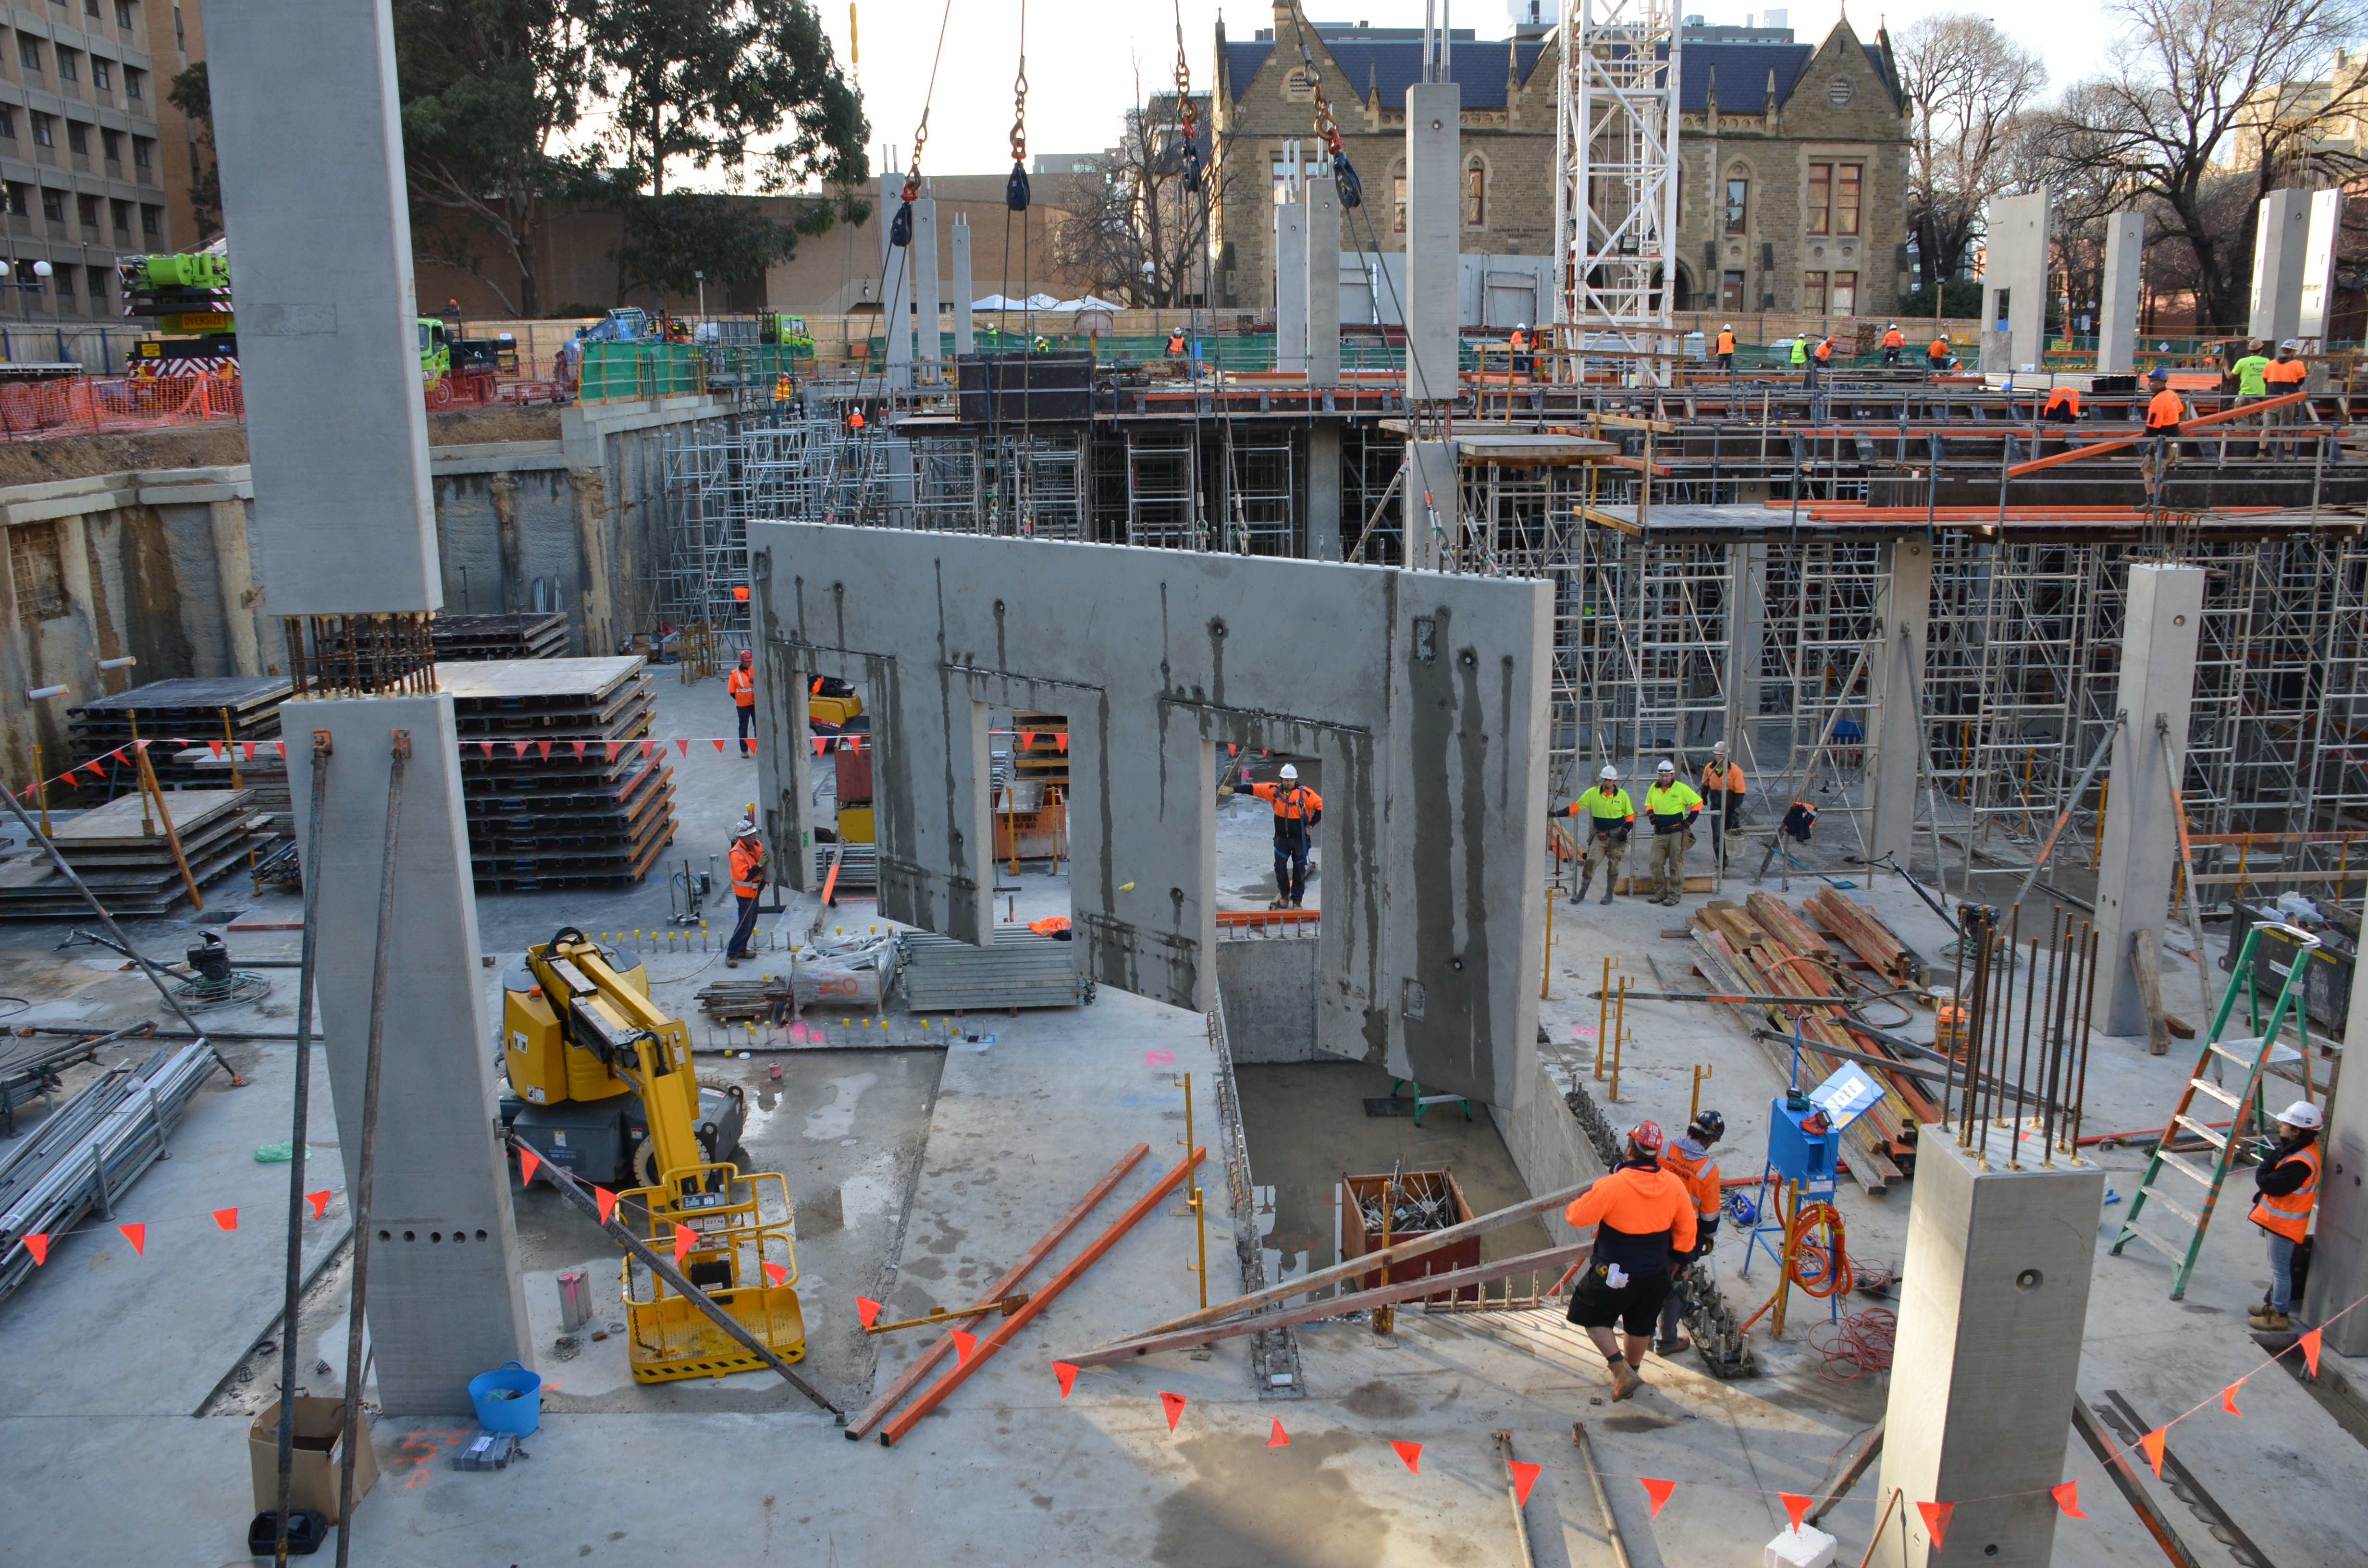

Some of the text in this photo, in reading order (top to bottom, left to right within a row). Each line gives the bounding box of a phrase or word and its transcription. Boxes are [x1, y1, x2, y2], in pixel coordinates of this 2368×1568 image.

[184, 316, 222, 326] OVERSIZE
[2269, 961, 2285, 973] Phone
[1666, 1157, 1697, 1176] NATIONAL
[1669, 1167, 1691, 1181] CRANE
